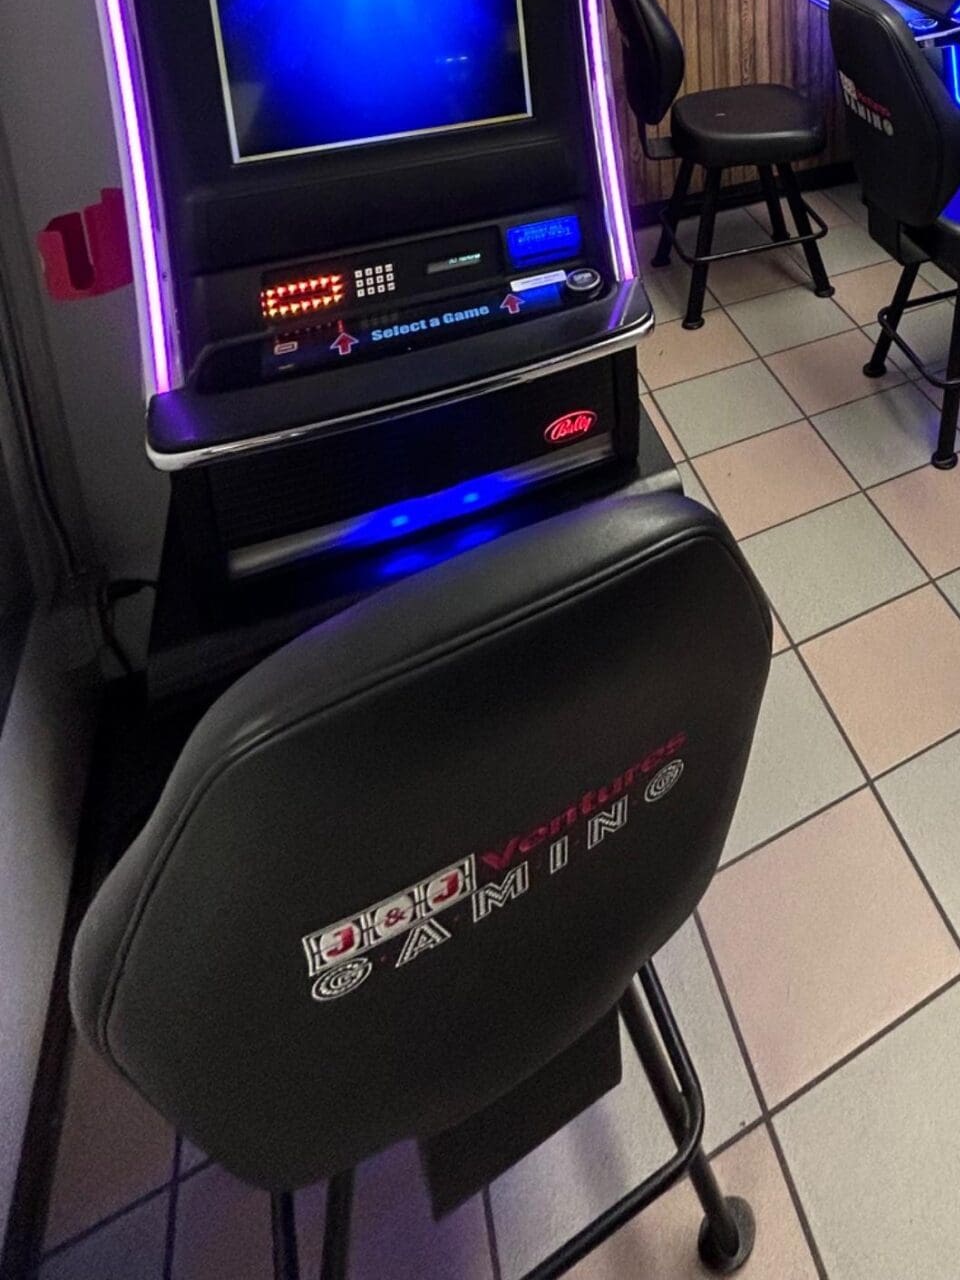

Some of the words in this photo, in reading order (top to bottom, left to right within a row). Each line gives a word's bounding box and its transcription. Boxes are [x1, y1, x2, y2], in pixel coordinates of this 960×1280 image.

[371, 320, 427, 342] Select
[428, 317, 441, 329] a
[443, 304, 490, 325] Game
[551, 415, 592, 440] Bally
[302, 852, 476, 978] J&J
[480, 730, 689, 873] Ventures
[310, 757, 685, 1002] GAMING
